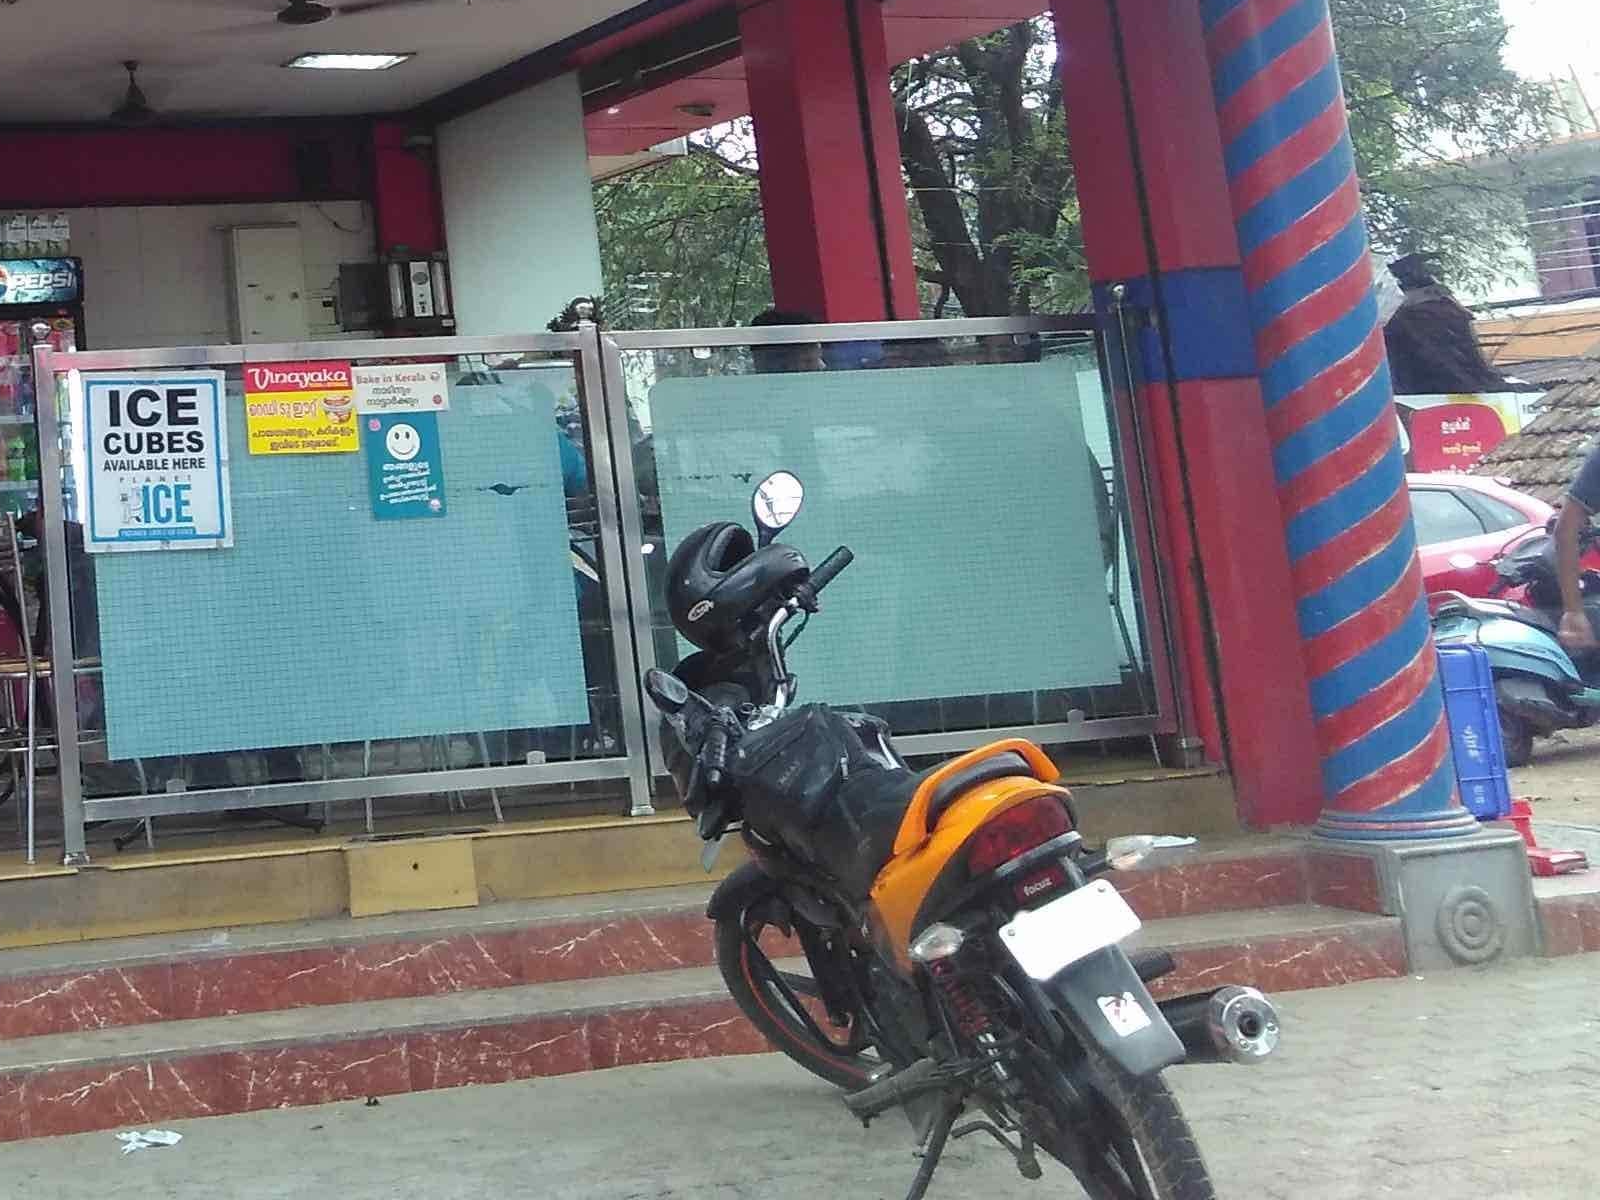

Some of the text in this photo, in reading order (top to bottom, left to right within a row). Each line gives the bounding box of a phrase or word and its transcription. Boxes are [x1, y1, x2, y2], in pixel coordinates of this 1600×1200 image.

[9, 272, 74, 290] PEPSI
[247, 368, 349, 389] Vinayaka
[395, 372, 426, 382] Kerala
[108, 388, 200, 428] ICE
[103, 431, 205, 455] CUBES
[103, 457, 206, 472] AVAILABLE HERE
[142, 484, 193, 524] ICE
[1023, 877, 1053, 897] focuz
